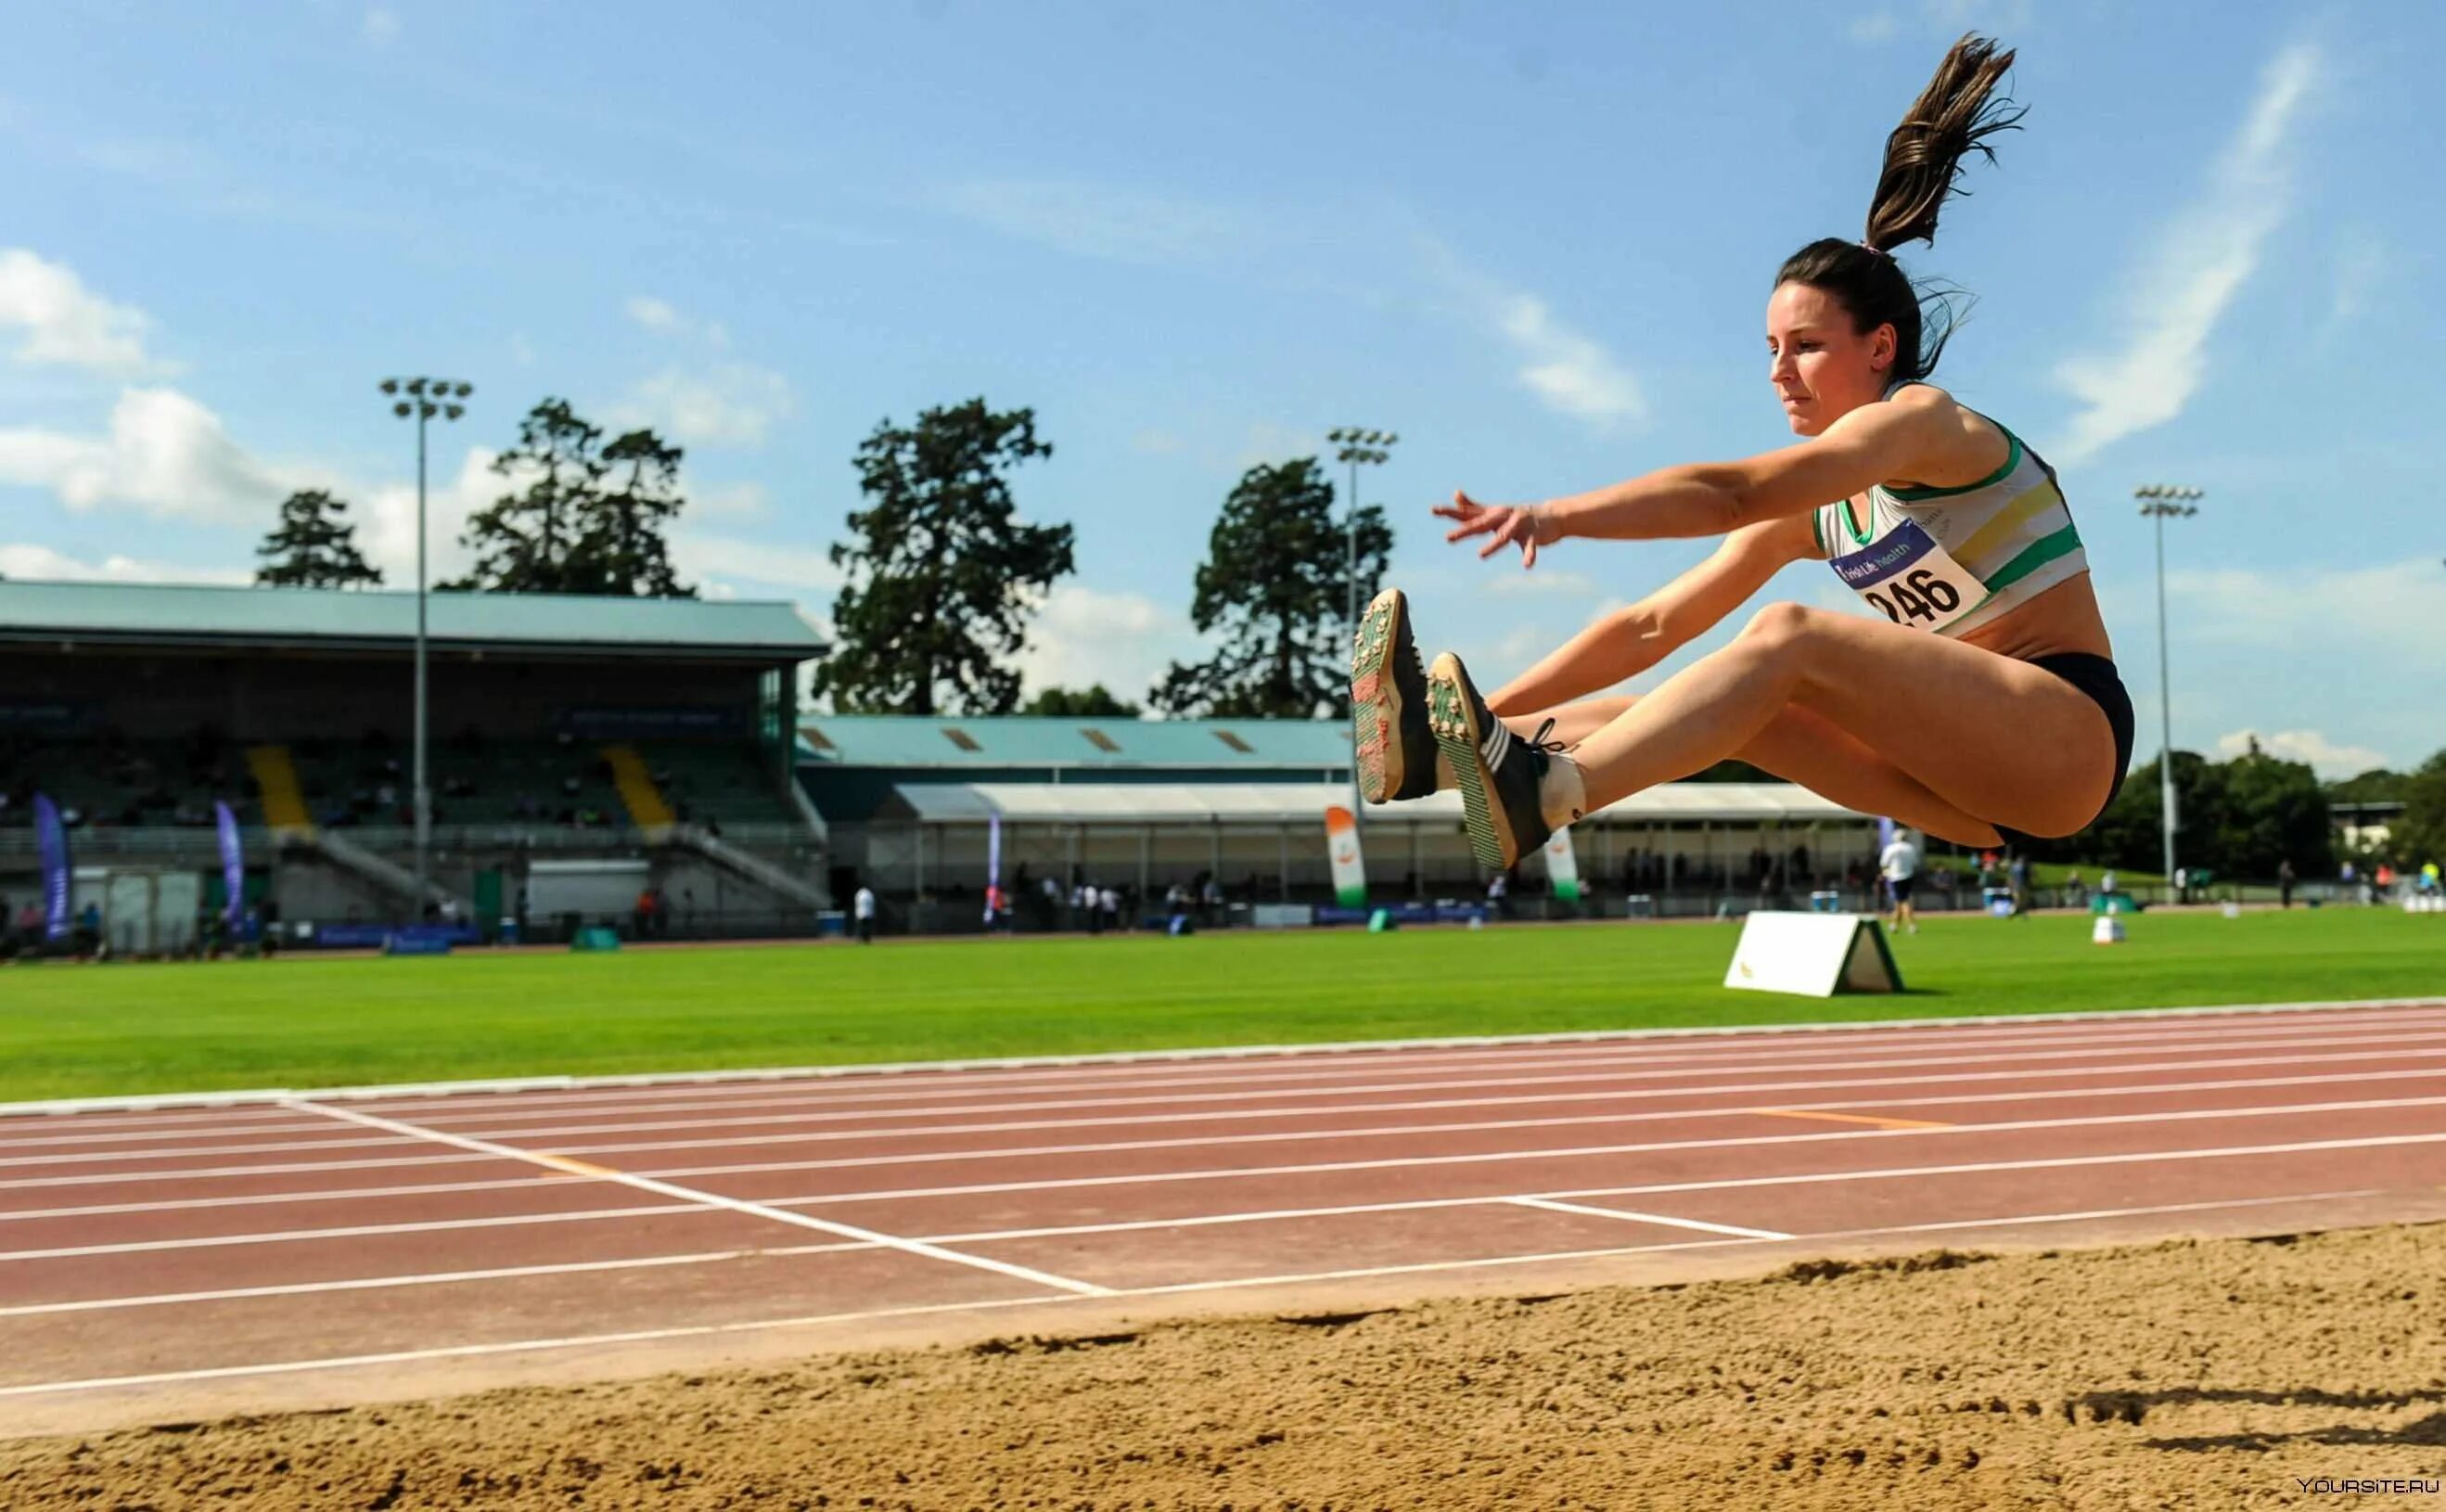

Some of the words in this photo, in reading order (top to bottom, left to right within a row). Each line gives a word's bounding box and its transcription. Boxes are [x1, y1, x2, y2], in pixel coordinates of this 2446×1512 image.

[1859, 560, 1879, 575] Life
[1874, 544, 1911, 570] health
[1865, 569, 1960, 628] 246
